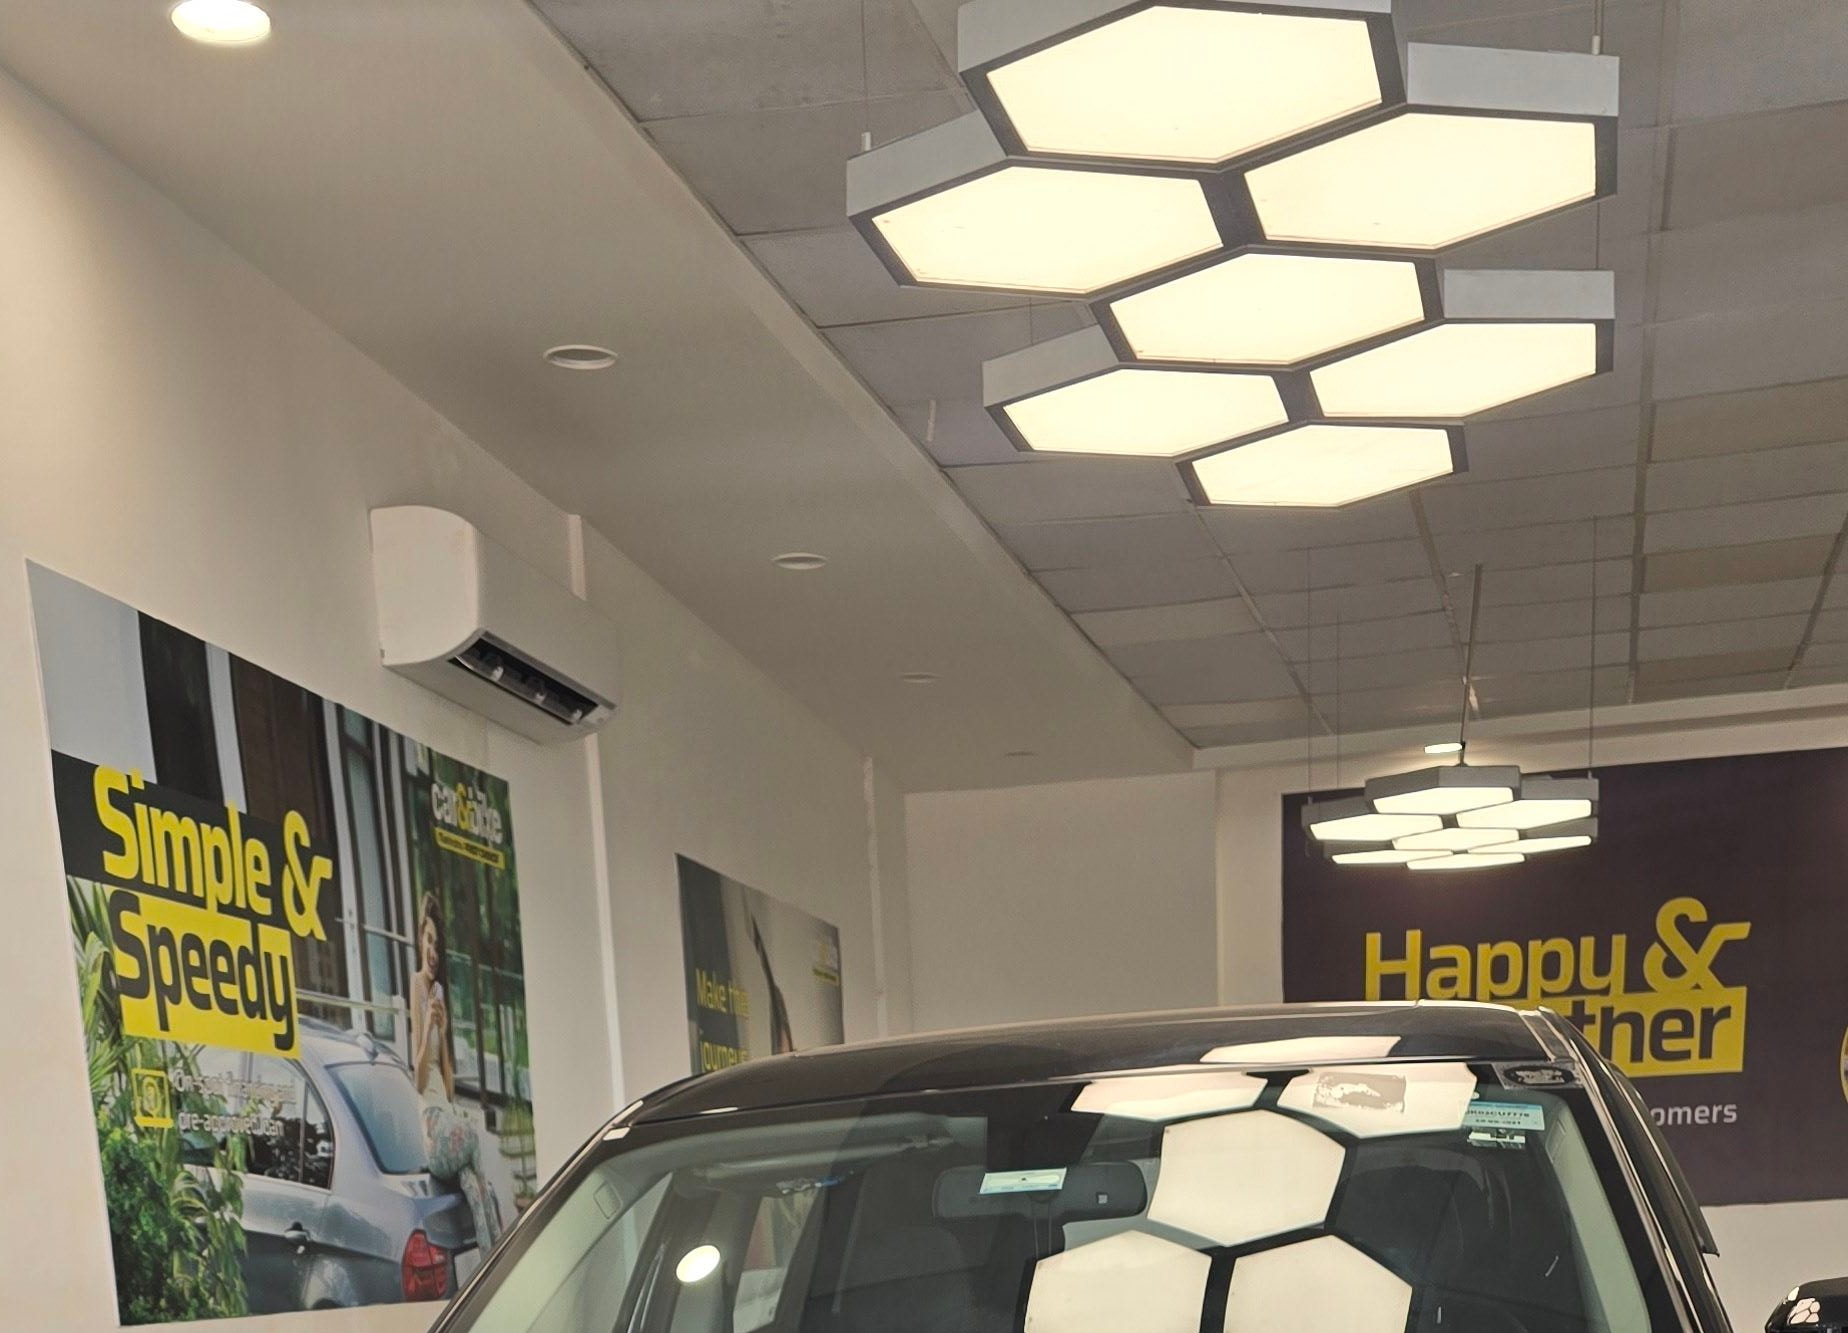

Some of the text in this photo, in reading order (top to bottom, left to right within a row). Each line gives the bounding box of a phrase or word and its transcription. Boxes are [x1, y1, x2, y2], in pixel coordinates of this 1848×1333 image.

[93, 764, 333, 942] Simple &
[431, 783, 503, 844] car&bike
[110, 889, 297, 1053] Speedy
[1364, 896, 1752, 1004] Happy &
[1566, 1000, 1732, 1065] ther
[1650, 1103, 1738, 1126] omers
